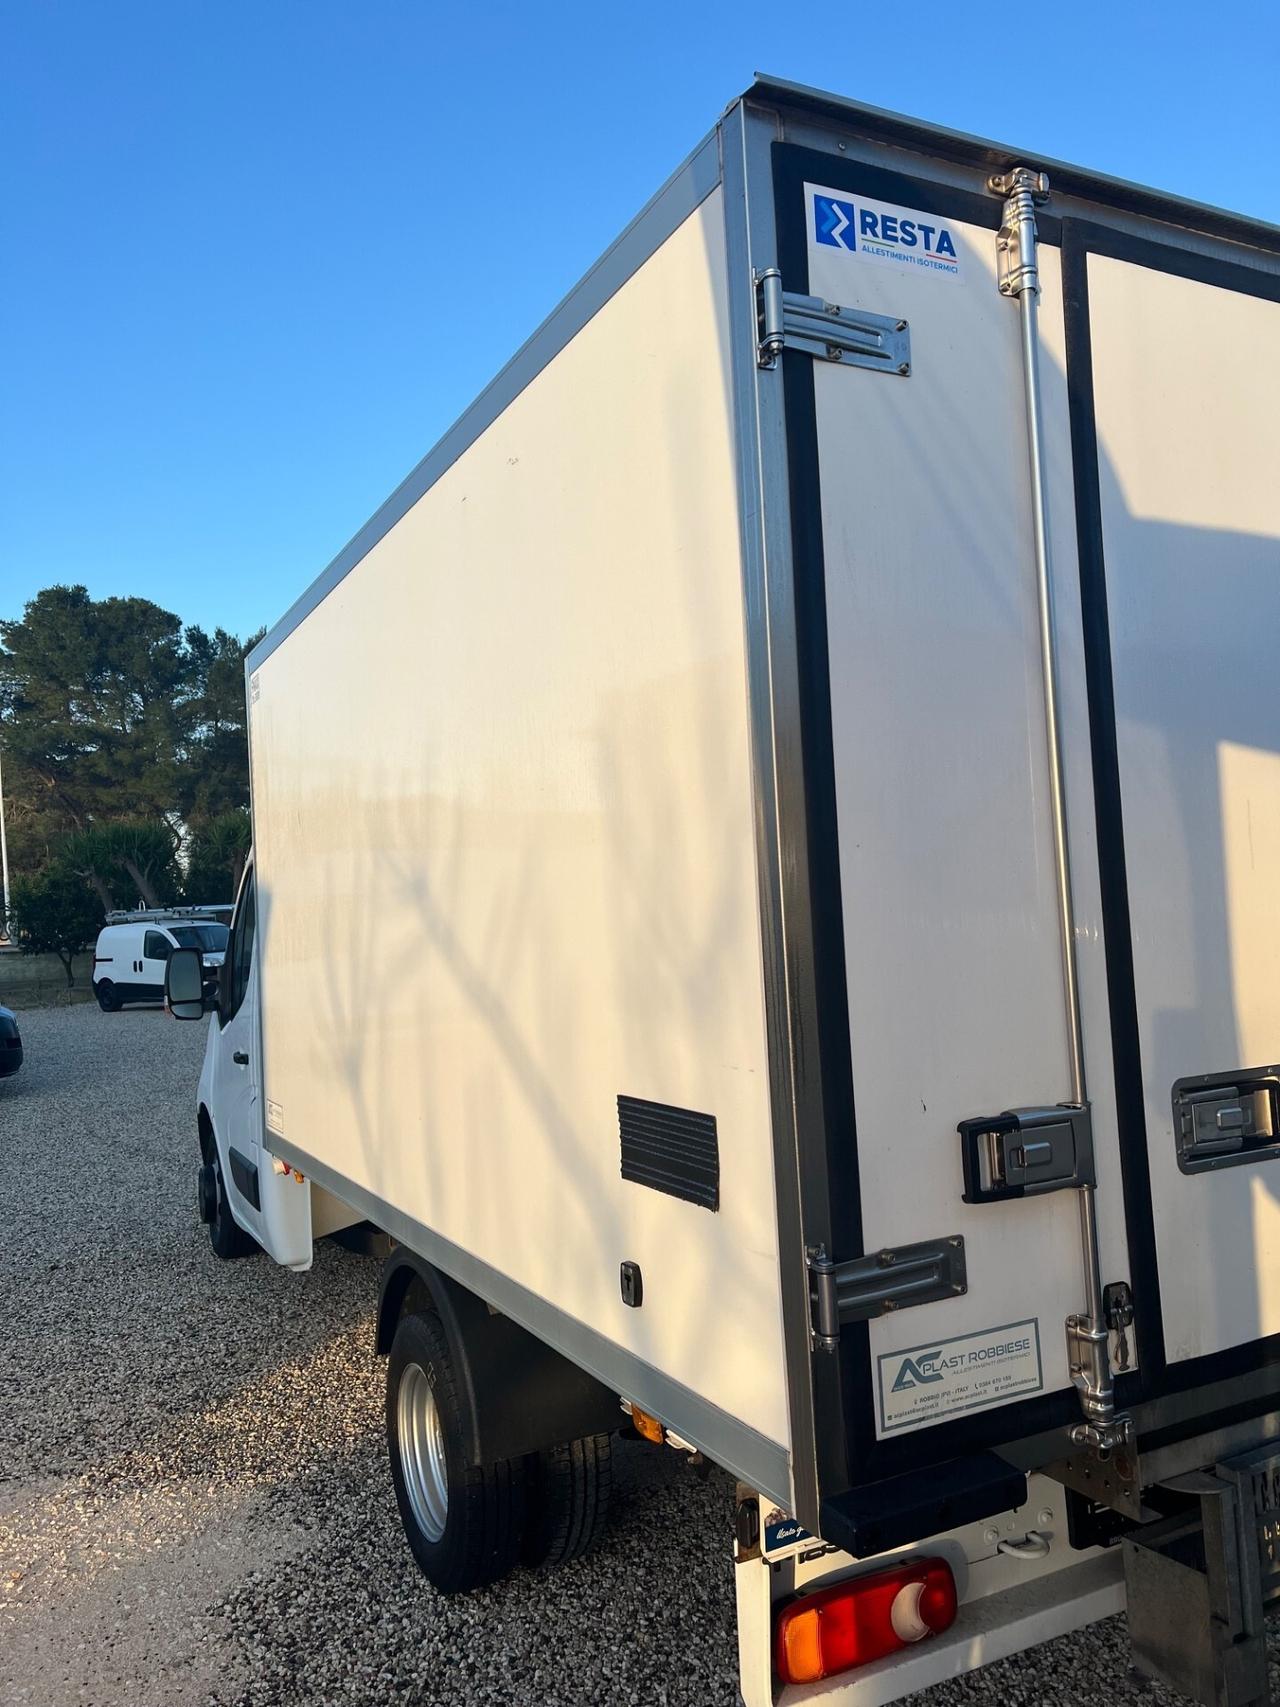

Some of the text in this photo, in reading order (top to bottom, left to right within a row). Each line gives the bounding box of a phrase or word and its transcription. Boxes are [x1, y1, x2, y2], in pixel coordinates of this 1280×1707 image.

[860, 209, 956, 257] RESTA
[862, 244, 959, 274] ALLESTIMENTI ISOTERMICI
[968, 1338, 1031, 1363] ROBBIESE
[919, 1392, 940, 1404] ROBBIO
[954, 1386, 970, 1397] ITALY
